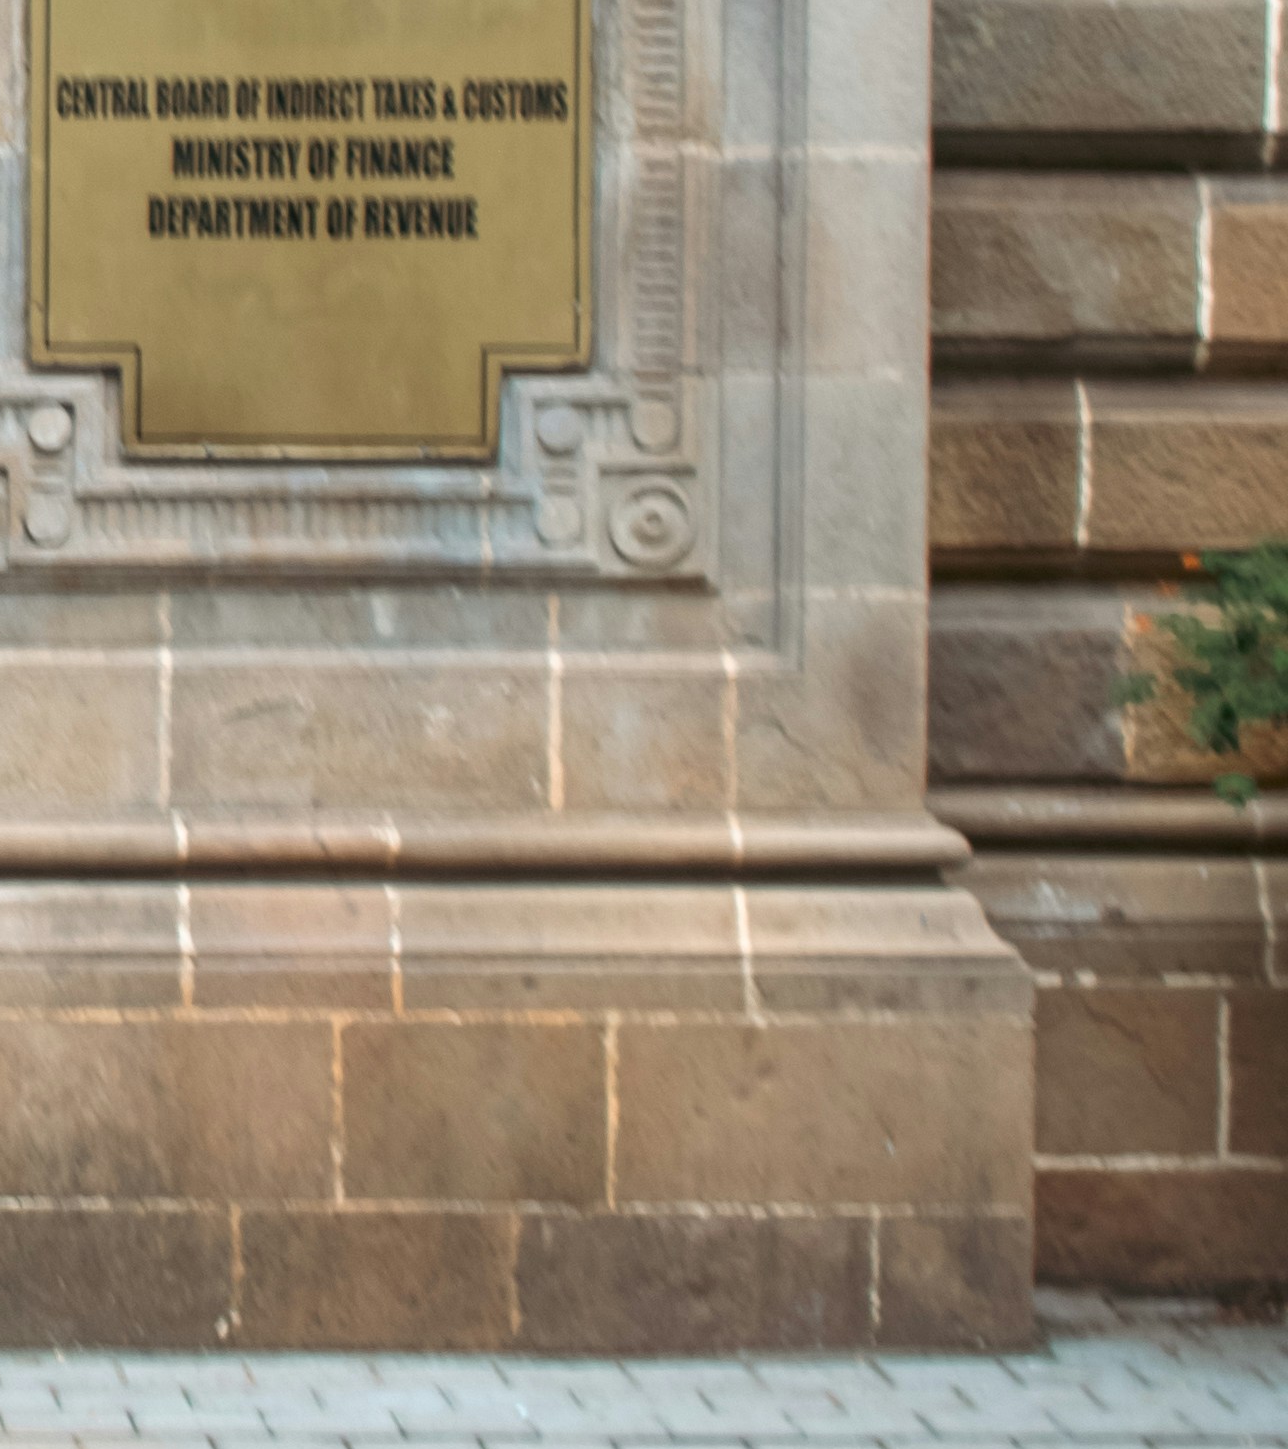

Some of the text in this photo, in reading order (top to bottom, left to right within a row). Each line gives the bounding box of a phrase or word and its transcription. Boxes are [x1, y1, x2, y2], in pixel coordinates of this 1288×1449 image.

[56, 76, 569, 121] CENTRAL BOARD OF INDIRECT TAXES & CUSTOMS
[171, 136, 455, 180] MINISTRY OF FINANCE
[148, 196, 479, 240] DEPARTMENT OF REVENUE
